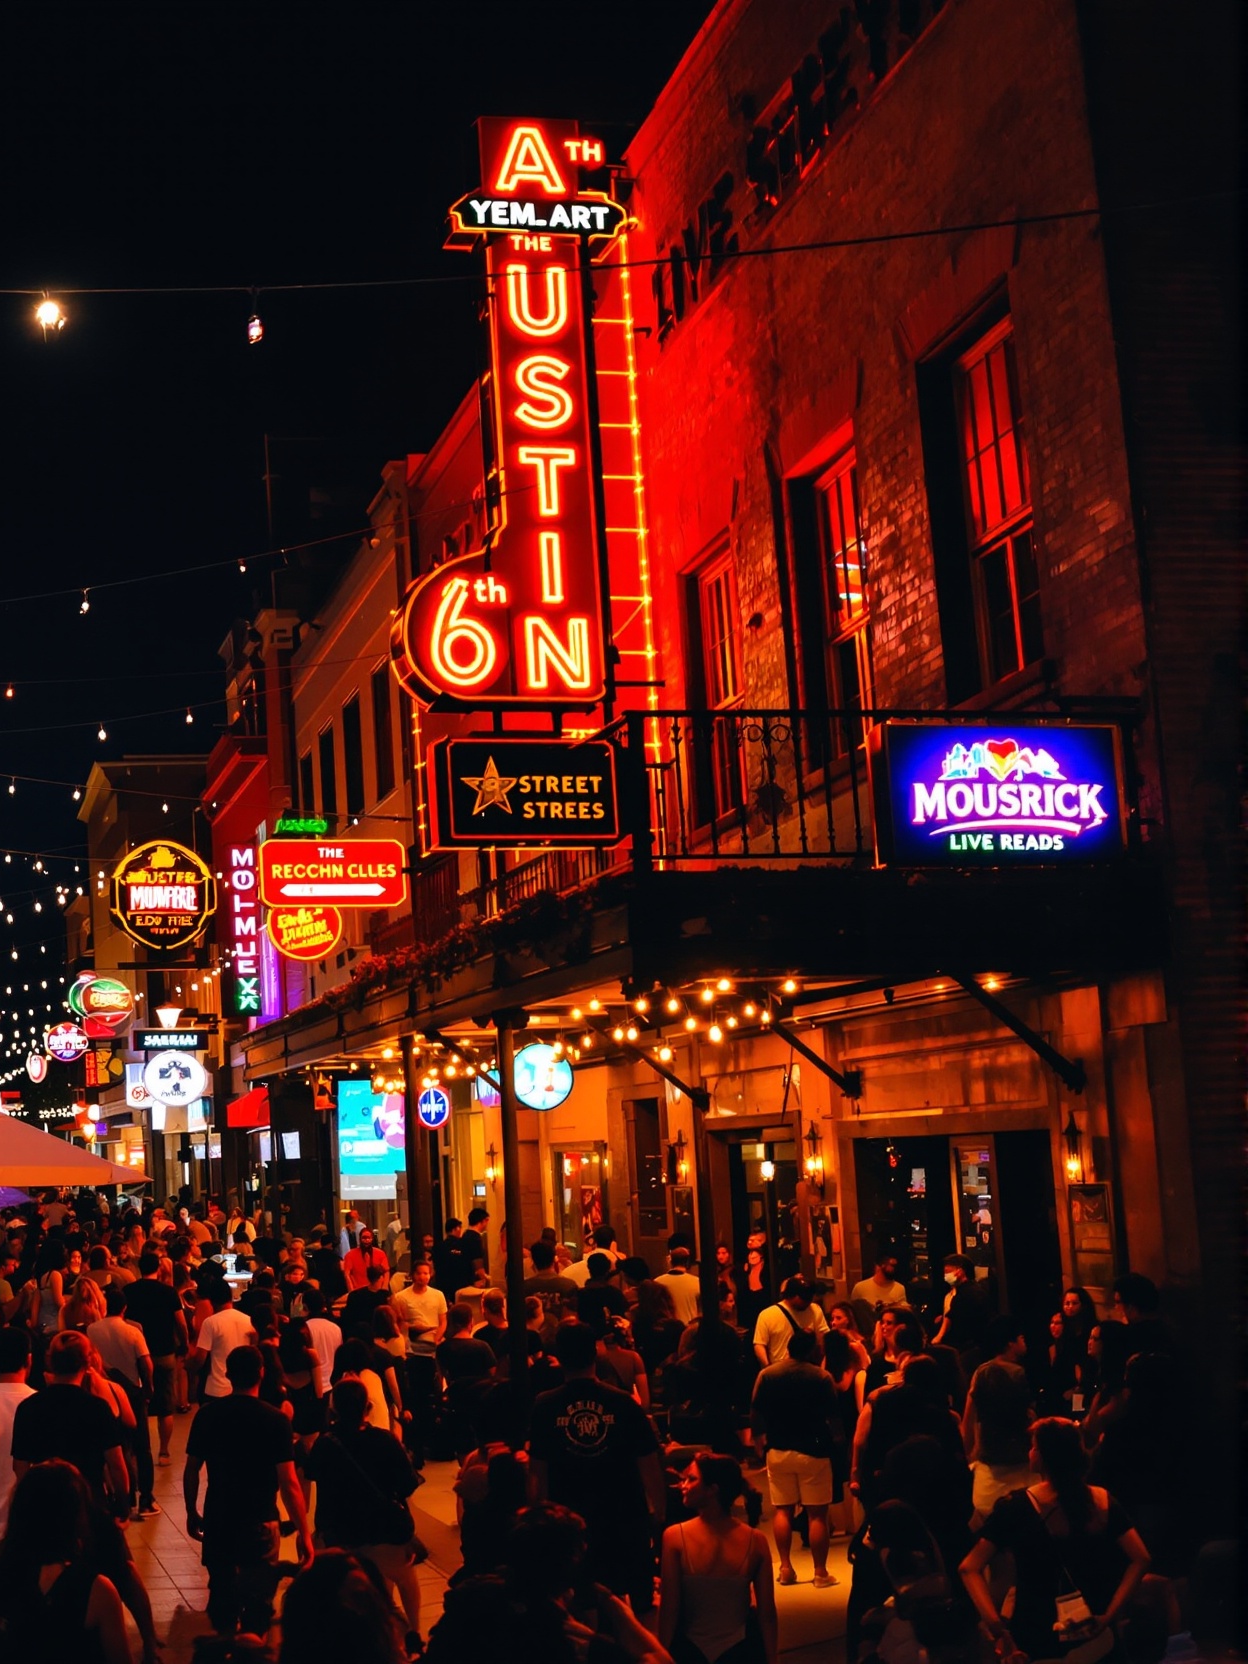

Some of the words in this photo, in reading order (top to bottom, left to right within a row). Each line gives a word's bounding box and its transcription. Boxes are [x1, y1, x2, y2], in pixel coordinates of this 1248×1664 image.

[510, 234, 553, 252] THE
[430, 576, 509, 688] 6th
[518, 775, 603, 794] STREET
[522, 801, 605, 819] STREES
[911, 781, 1109, 826] MOUSRICK
[949, 833, 994, 851] LIVE
[999, 833, 1066, 851] READS
[316, 846, 345, 859] THE
[270, 863, 344, 879] RECCHN
[346, 863, 397, 879] CLLES
